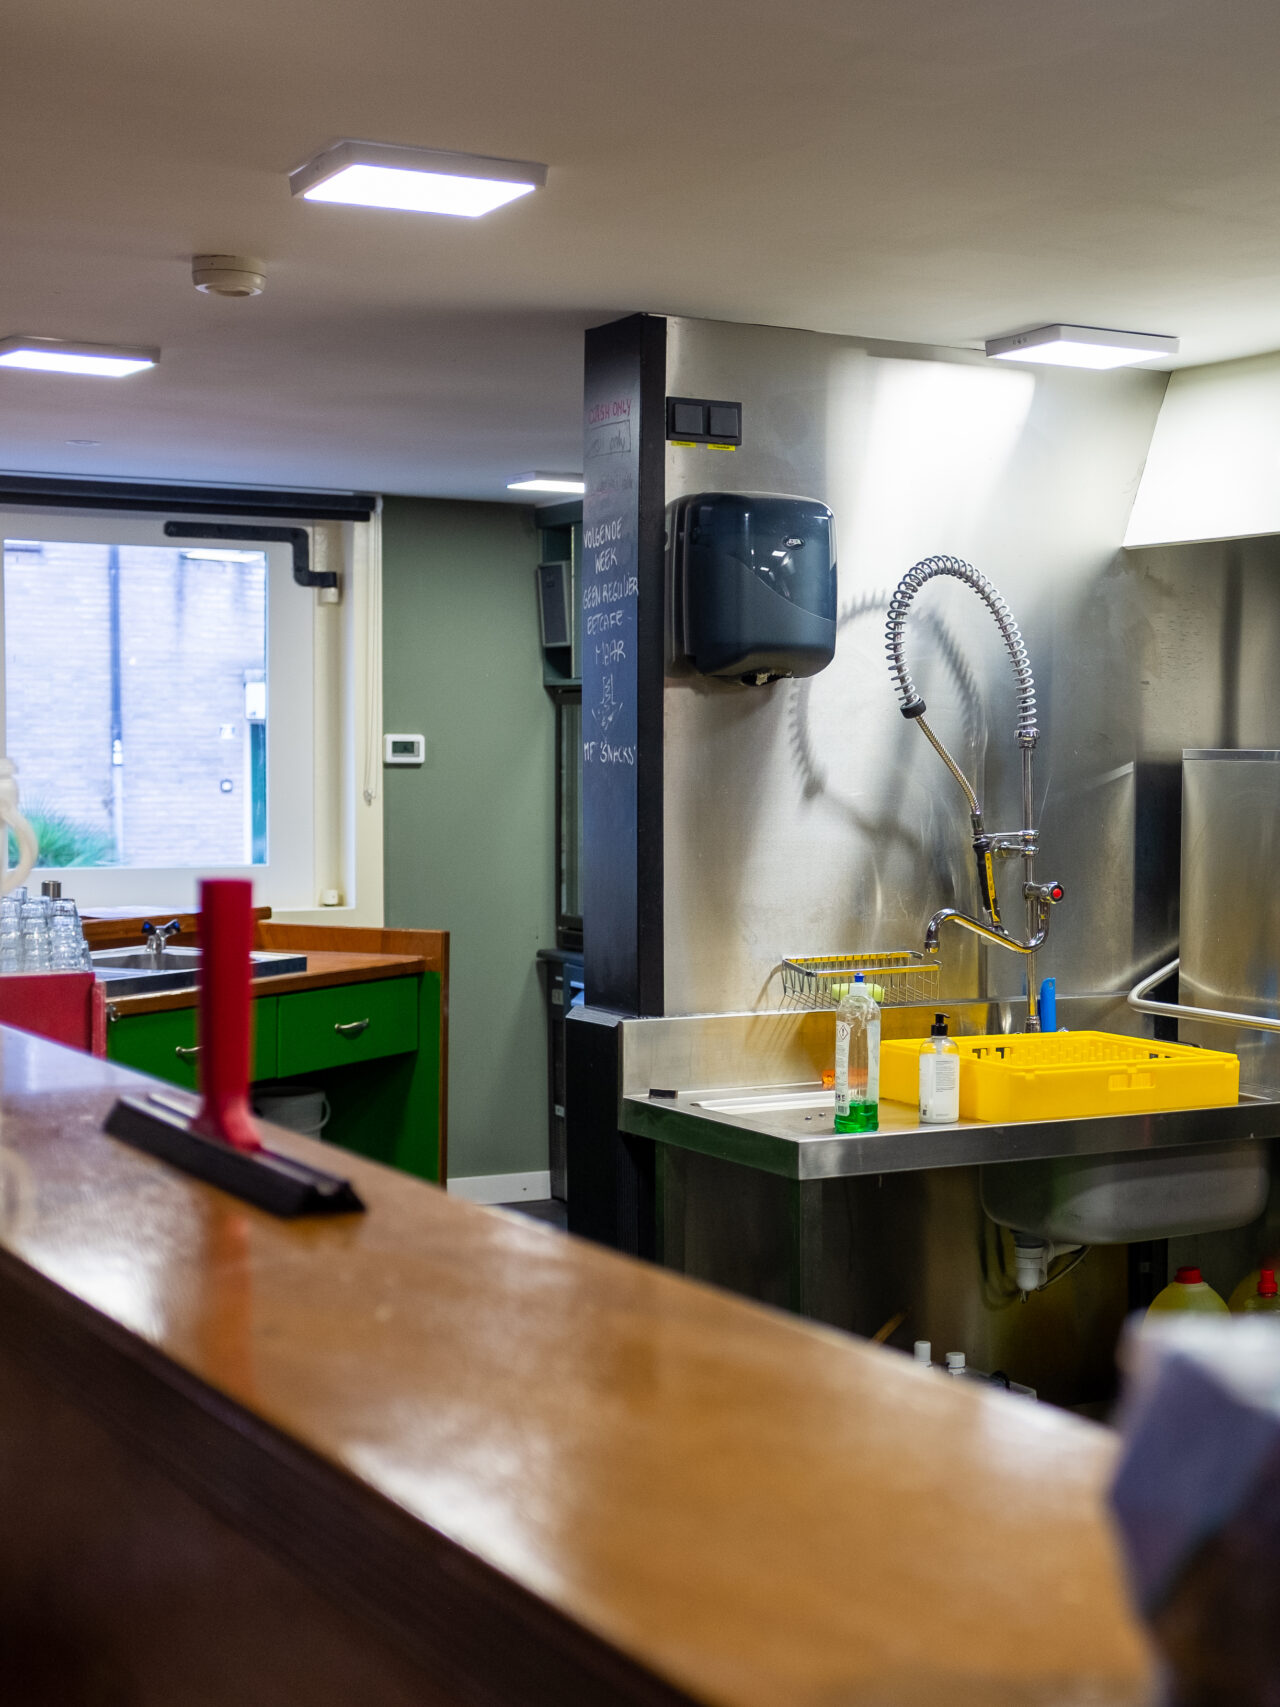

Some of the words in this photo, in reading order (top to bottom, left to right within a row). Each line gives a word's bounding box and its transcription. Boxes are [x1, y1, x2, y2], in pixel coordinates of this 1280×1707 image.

[583, 516, 623, 549] VOLGENDE
[595, 547, 617, 574] WEEK
[583, 584, 600, 609] GEEN
